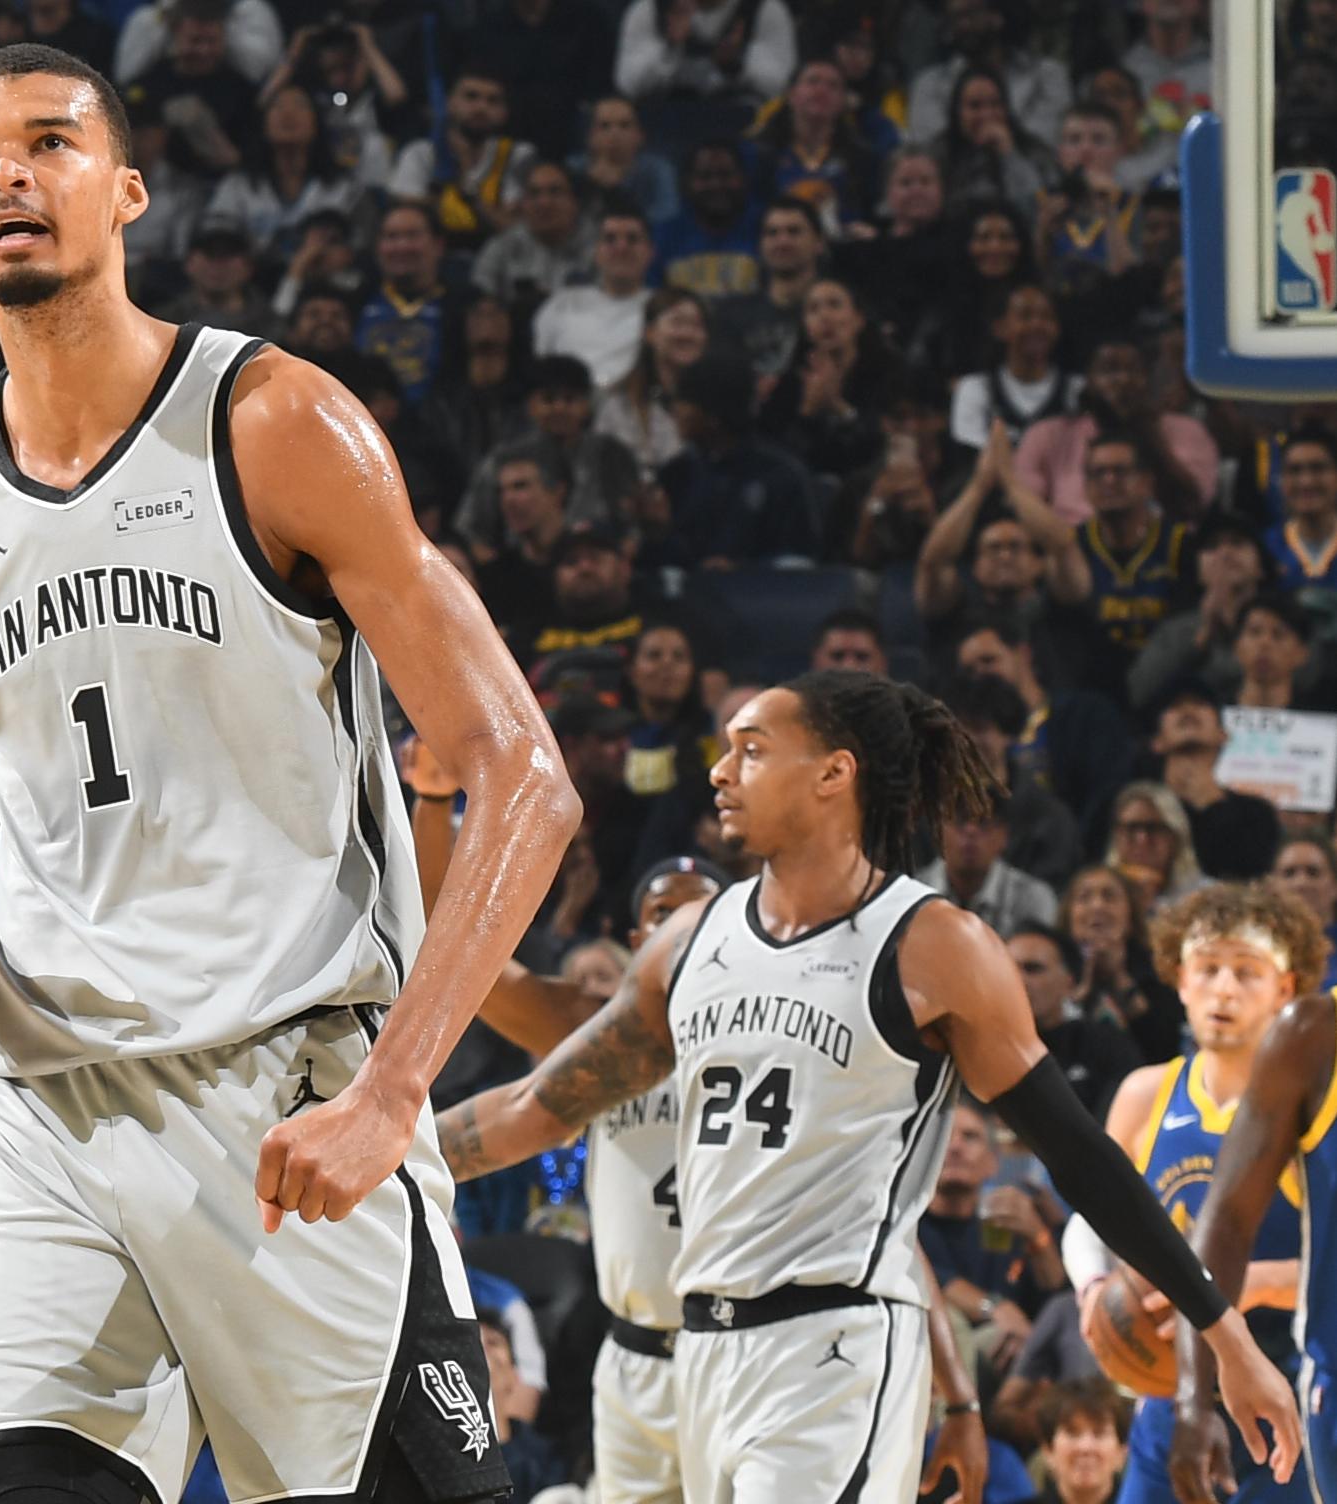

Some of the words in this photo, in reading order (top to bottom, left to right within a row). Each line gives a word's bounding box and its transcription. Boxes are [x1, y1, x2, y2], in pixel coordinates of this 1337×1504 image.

[125, 500, 183, 521] LEDGER
[34, 564, 224, 648] ANTONIO
[68, 681, 133, 812] 1
[678, 1002, 724, 1057] SAN
[728, 995, 854, 1070] ANTONIO
[607, 1096, 649, 1141] SAN
[697, 1065, 795, 1150] 24
[652, 1164, 682, 1229] 4
